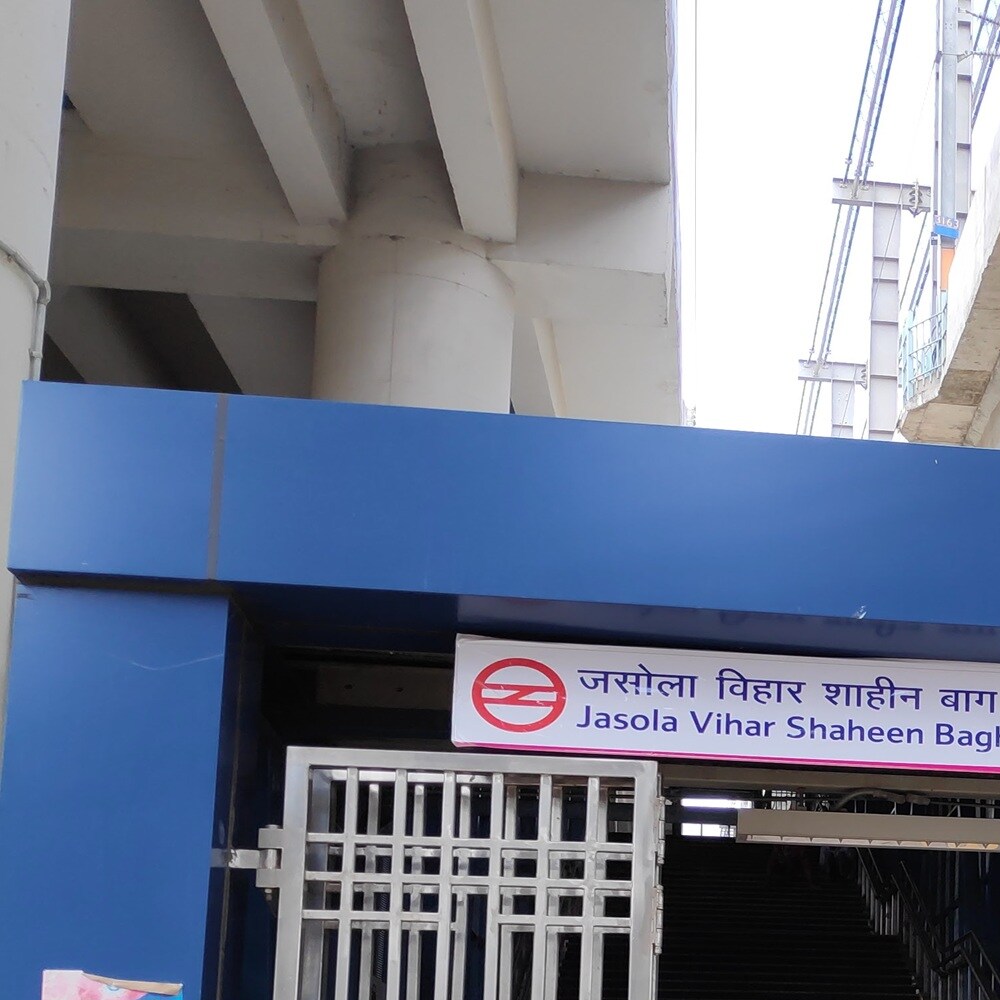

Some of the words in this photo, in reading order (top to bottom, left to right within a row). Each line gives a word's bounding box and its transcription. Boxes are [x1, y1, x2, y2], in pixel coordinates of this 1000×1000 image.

[579, 664, 698, 699] जसोला
[716, 667, 805, 705] विहार
[822, 675, 923, 711] शाहीन
[940, 688, 998, 714] बाग
[576, 705, 678, 733] Jasola
[689, 710, 776, 738] Vihar
[786, 715, 924, 745] Shaheen
